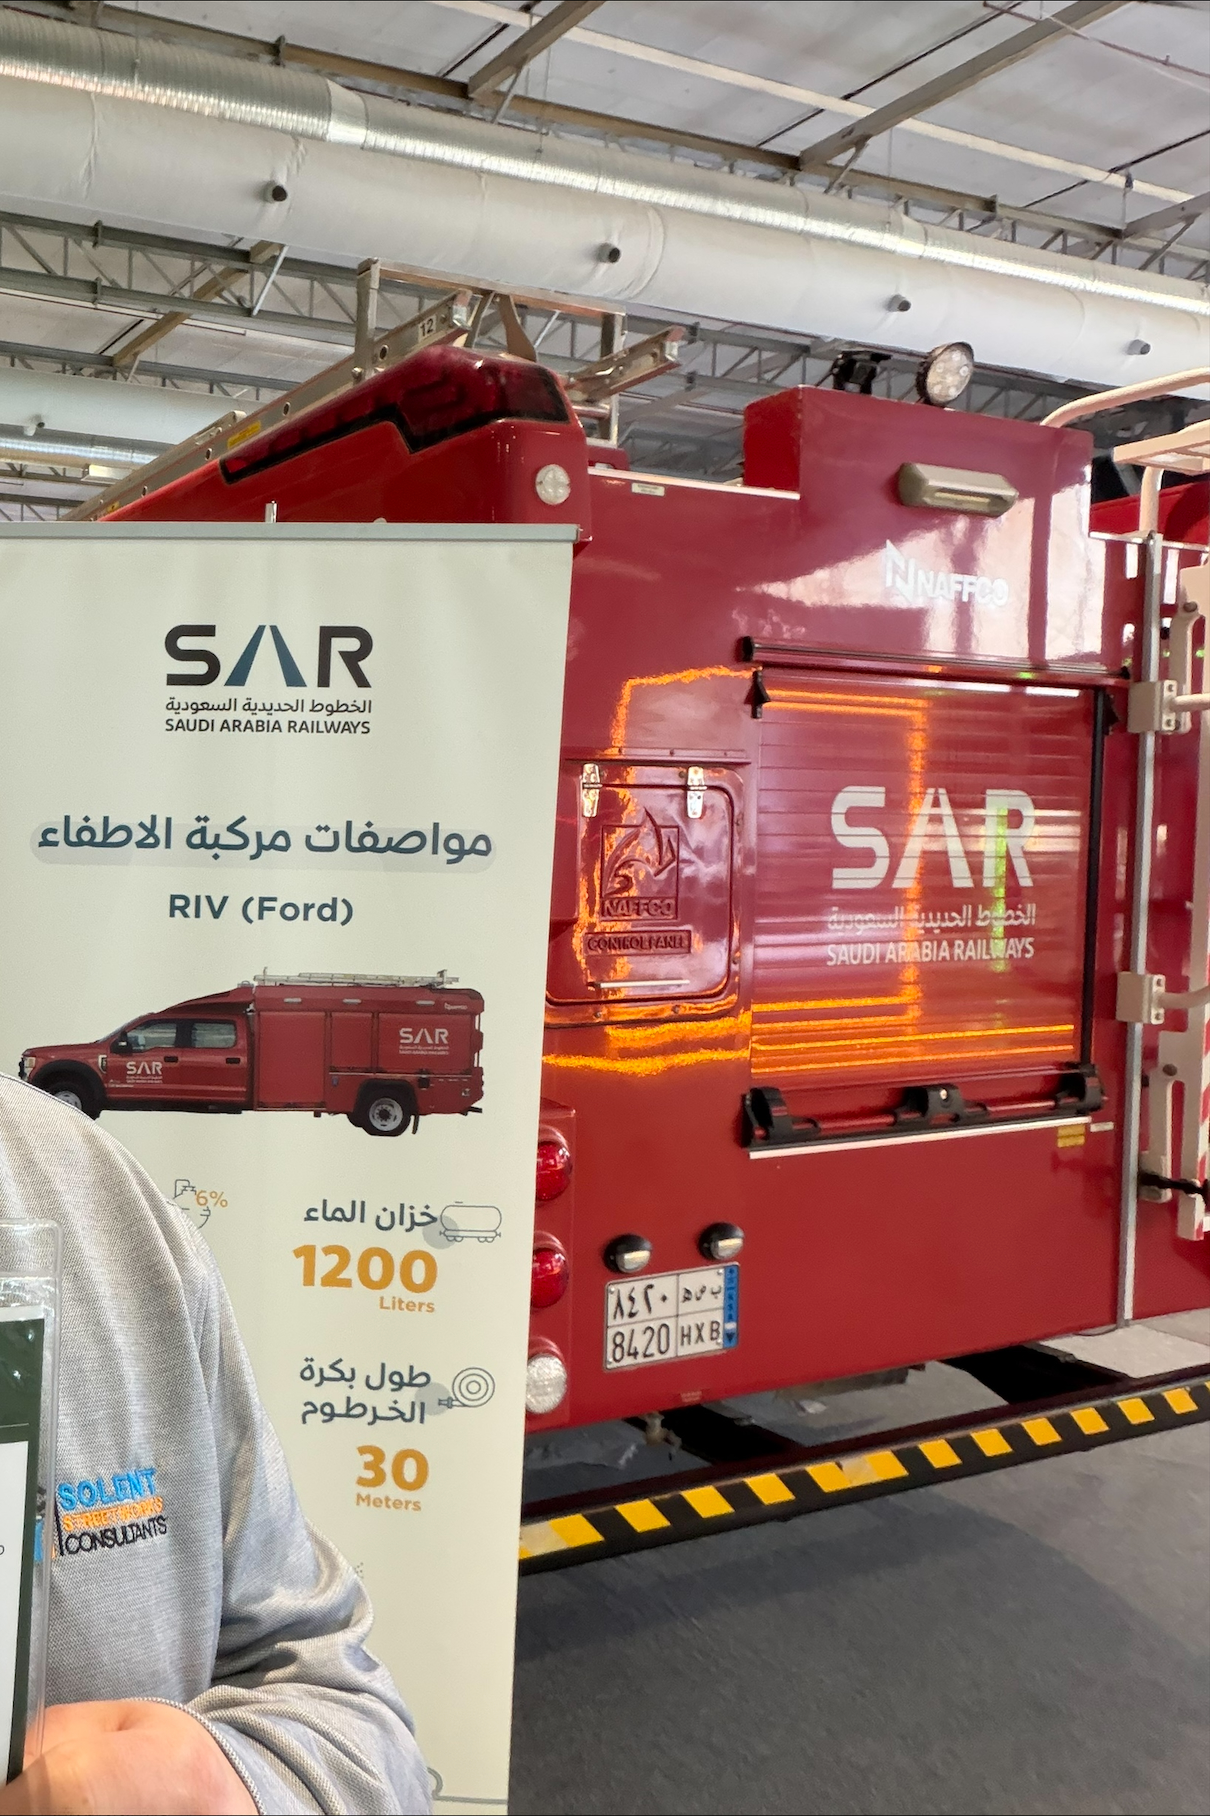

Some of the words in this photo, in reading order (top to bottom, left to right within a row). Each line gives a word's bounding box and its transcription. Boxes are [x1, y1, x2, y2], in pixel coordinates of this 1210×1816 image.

[420, 318, 433, 336] 12
[164, 624, 373, 688] SAR
[165, 697, 238, 714] السعودية
[242, 697, 305, 716] الحديدية
[309, 699, 373, 717] الخطوط
[165, 718, 215, 732] SAUDI
[219, 719, 283, 733] ARABIA
[287, 720, 371, 734] RAILWAYS
[38, 814, 173, 850] الاطفاء
[185, 815, 292, 861] مركبة
[304, 820, 492, 864] مواصفات
[831, 785, 1036, 889] SAR
[168, 894, 230, 920] RIV
[242, 896, 354, 926] (Ford)
[603, 899, 673, 917] NAFFCO
[587, 935, 646, 951] CONTROL
[827, 943, 880, 966] SAUDI
[885, 940, 950, 963] ARABIA
[954, 937, 1035, 960] RAILWAYS
[399, 1028, 449, 1044] SAR
[126, 1061, 162, 1075] SAR
[196, 1190, 228, 1208] 6%
[304, 1199, 366, 1223] الماء
[375, 1203, 438, 1232] خزان
[293, 1244, 438, 1294] 1200
[379, 1296, 435, 1313] Liters
[612, 1323, 670, 1363] 8420
[300, 1357, 356, 1389] بكرة
[365, 1362, 431, 1391] طول
[301, 1396, 426, 1426] الخرطوم
[356, 1445, 429, 1492] 30
[58, 1467, 157, 1511] SOLENT
[355, 1493, 422, 1512] Meters
[63, 1496, 164, 1532] STREETWORKS
[65, 1514, 168, 1555] CONSULTANTS
